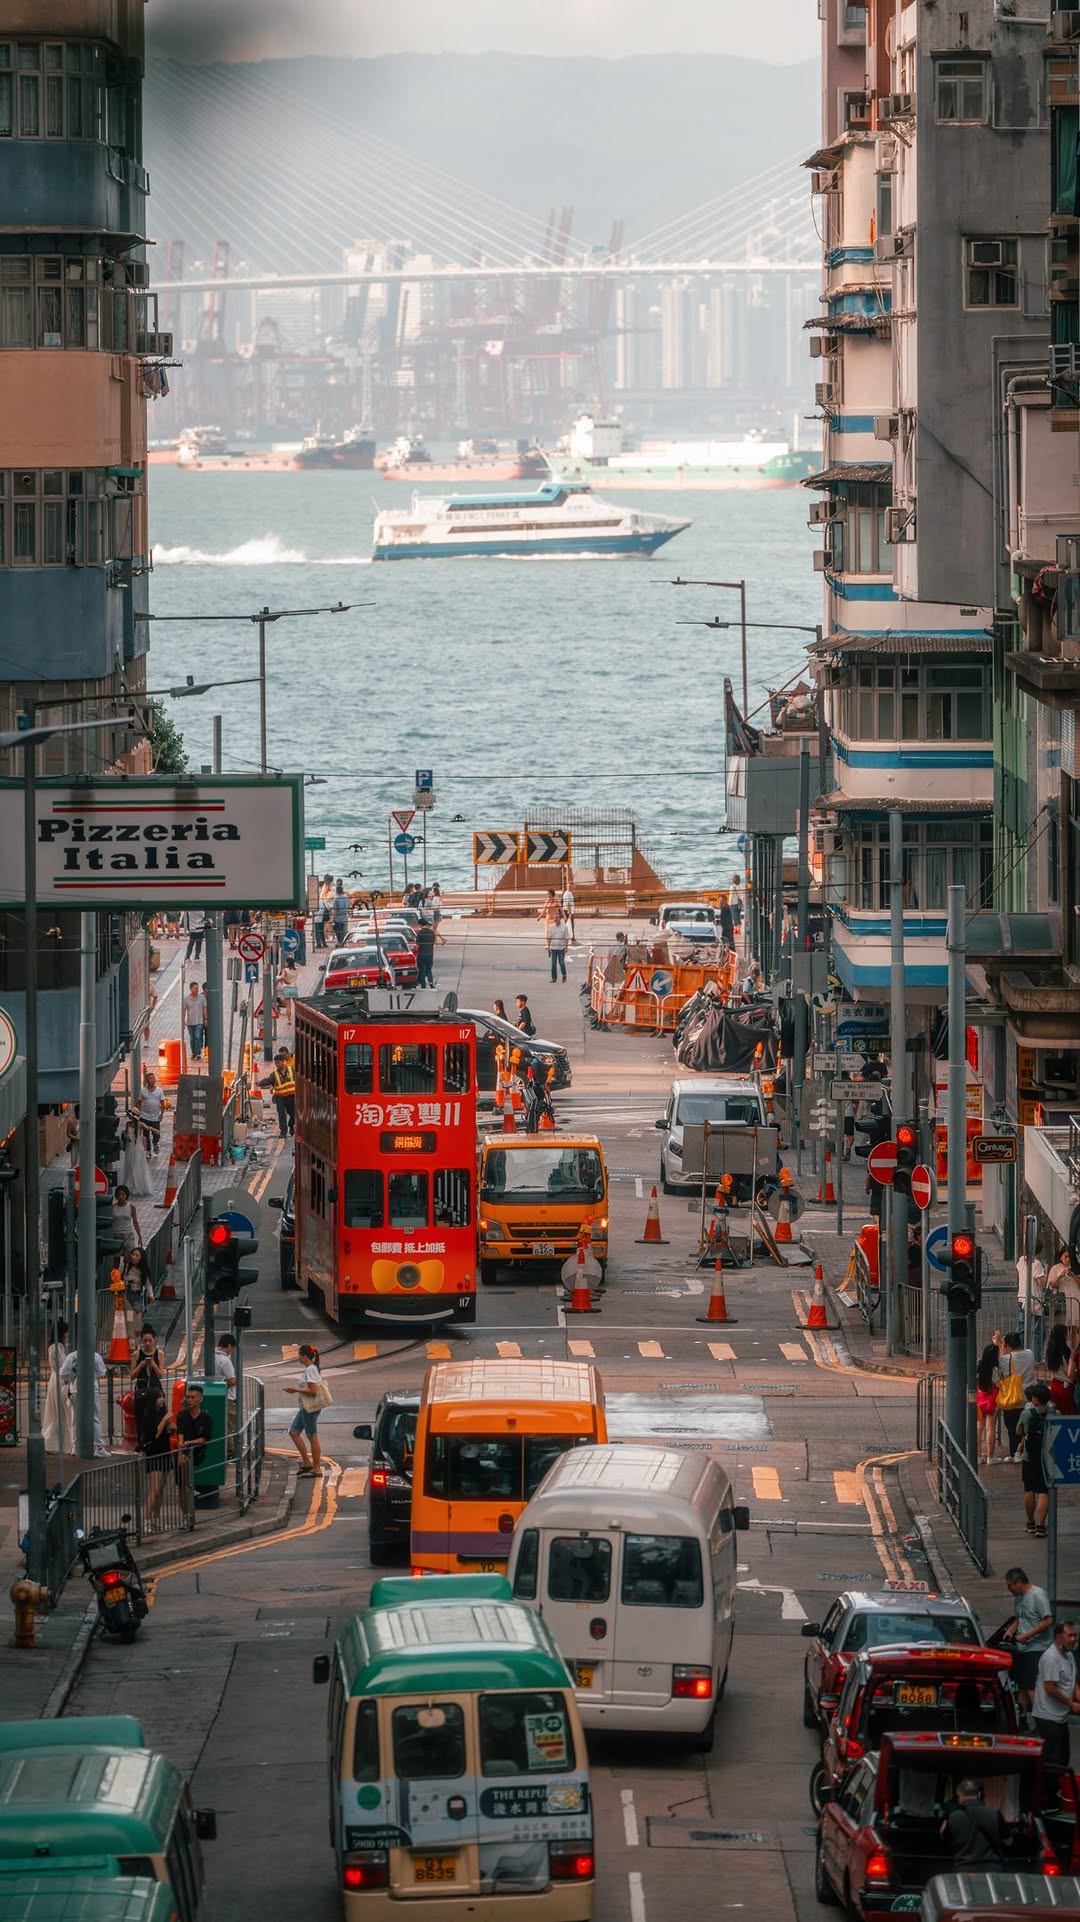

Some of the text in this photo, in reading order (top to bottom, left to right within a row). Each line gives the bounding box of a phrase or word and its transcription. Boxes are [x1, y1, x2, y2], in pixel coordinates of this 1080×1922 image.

[38, 818, 240, 842] Pizzeria
[63, 846, 215, 870] Italia
[389, 993, 415, 1010] 117
[343, 1030, 356, 1040] 117
[459, 1029, 471, 1039] 117
[978, 1142, 1006, 1153] Century
[1003, 1147, 1012, 1157] 21
[459, 1297, 471, 1308] 117
[888, 1581, 925, 1590] TAXI
[901, 1694, 932, 1703] 8088
[492, 1788, 546, 1800] THE REPU
